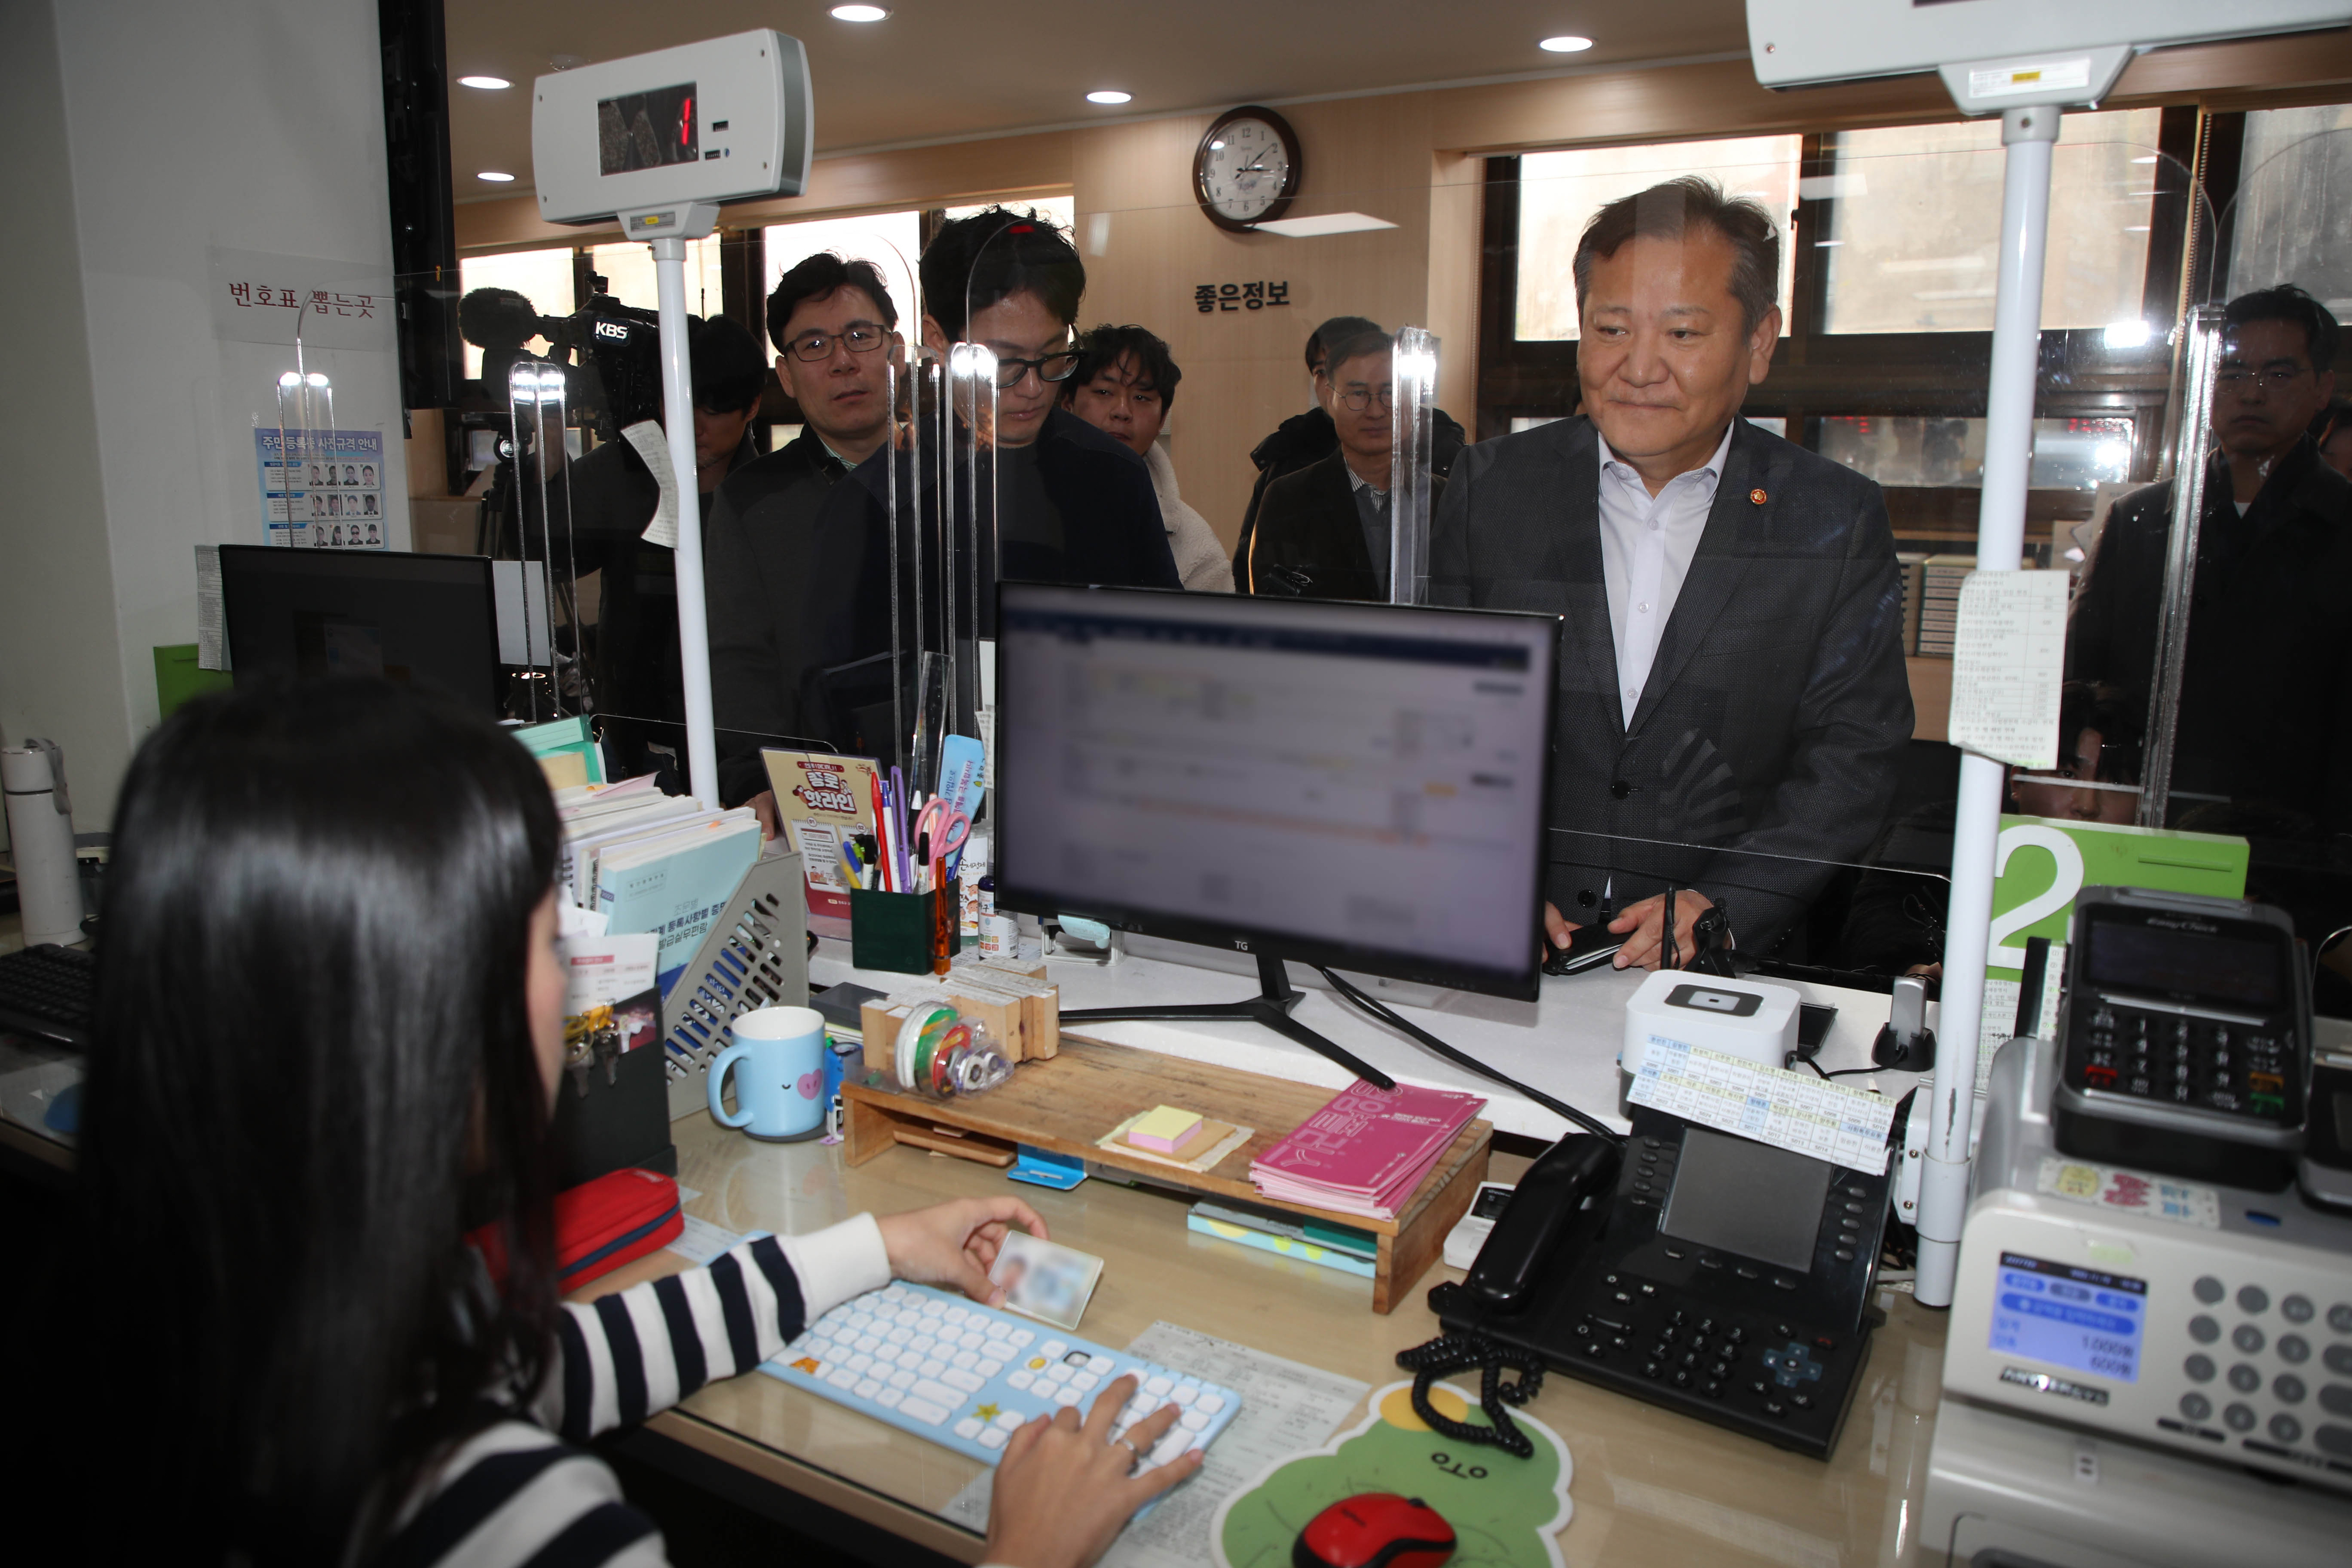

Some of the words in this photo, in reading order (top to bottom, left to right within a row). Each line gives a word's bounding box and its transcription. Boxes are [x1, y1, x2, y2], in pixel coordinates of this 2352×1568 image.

[1242, 128, 1251, 138] 12
[1261, 131, 1264, 141] 1
[1227, 135, 1235, 145] 11
[1272, 143, 1278, 153] 2
[1215, 151, 1224, 161] 10
[1278, 162, 1283, 170] 3
[1210, 169, 1215, 178] 9
[1216, 188, 1221, 196] 8
[1228, 199, 1233, 209] 7
[1244, 202, 1249, 211] 6
[229, 282, 300, 309] 번호표
[310, 290, 375, 319] 뽑는곳
[1195, 280, 1291, 314] 좋은정보
[595, 322, 628, 339] KBS
[358, 438, 377, 451] 안내
[807, 771, 840, 790] 종로
[804, 790, 856, 812] 핫라인
[1986, 824, 2084, 969] 2
[668, 908, 709, 933] 등록사항별
[1235, 940, 1248, 951] TG
